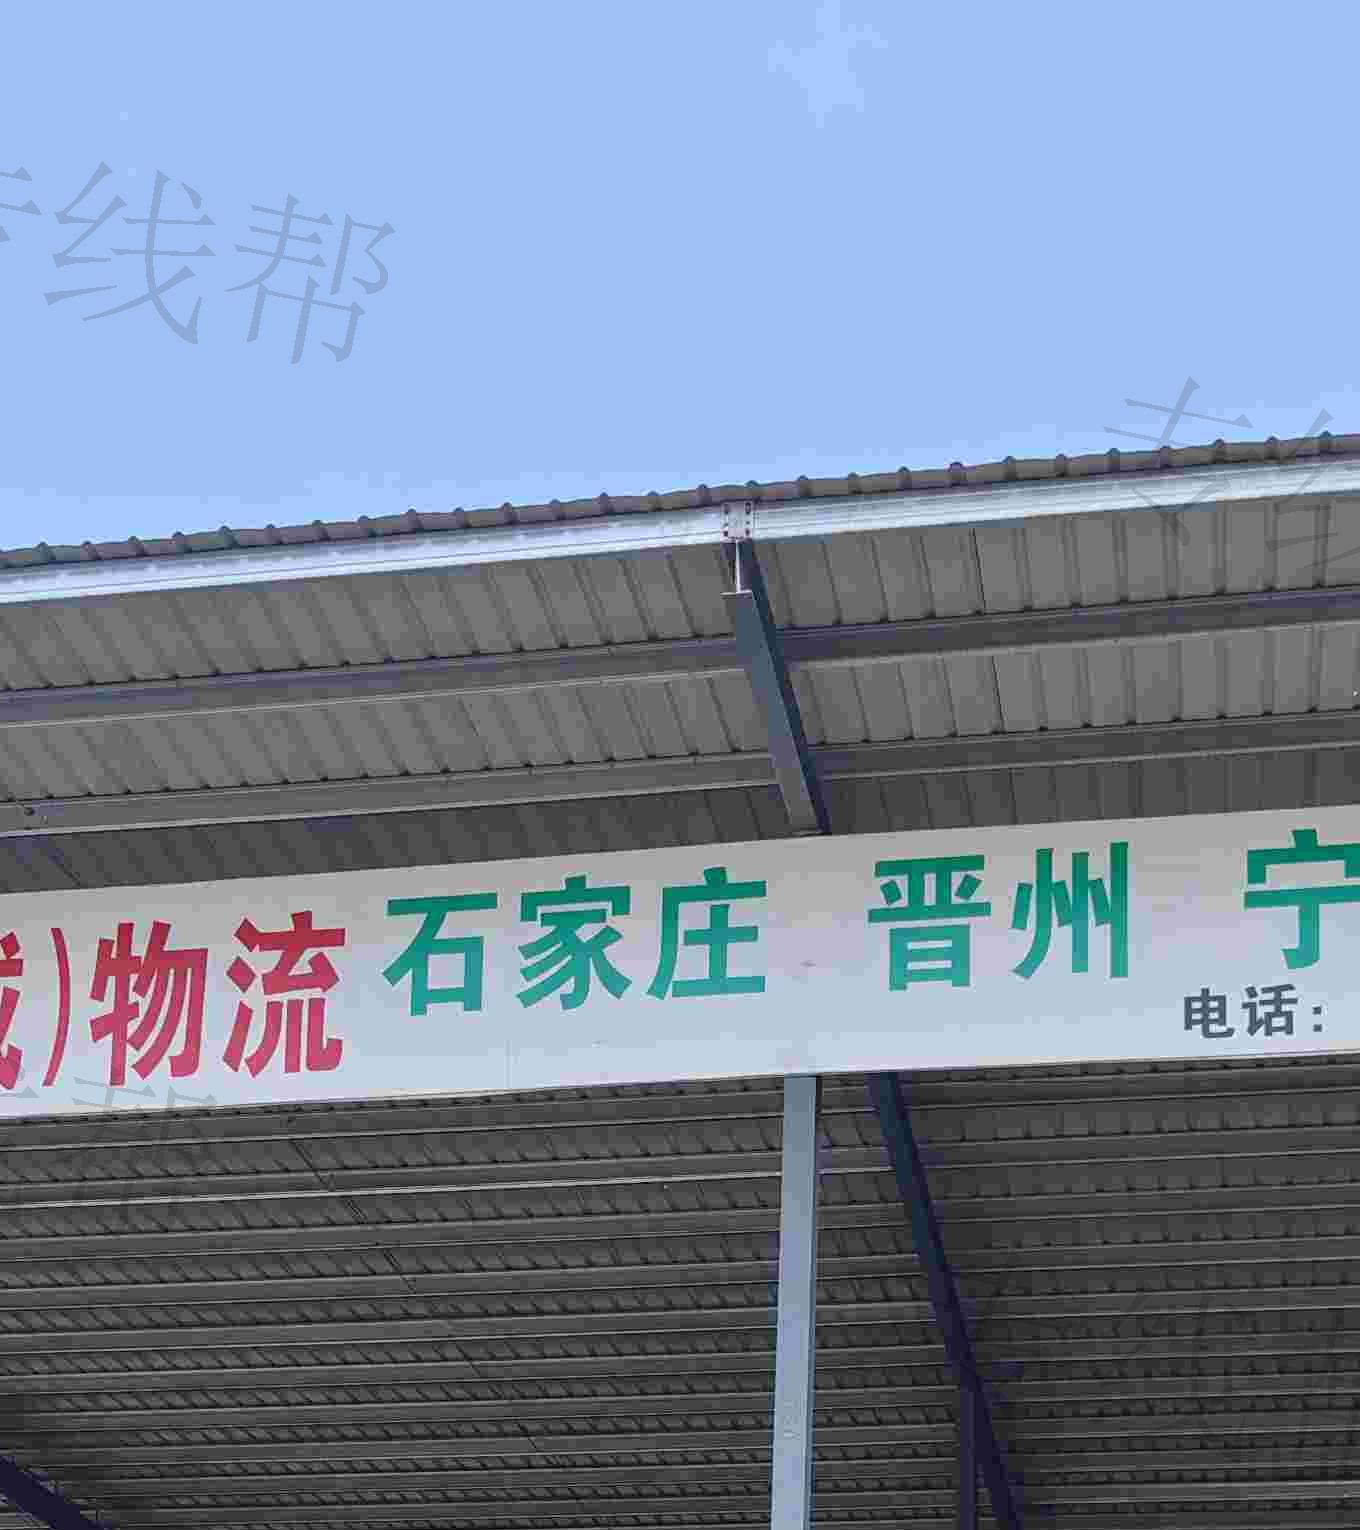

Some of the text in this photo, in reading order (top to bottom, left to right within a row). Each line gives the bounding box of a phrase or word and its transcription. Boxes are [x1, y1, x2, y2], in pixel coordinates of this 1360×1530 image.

[382, 866, 767, 1017] 石家庄
[866, 841, 1129, 991] 晋州
[1183, 985, 1325, 1040] 电话:
